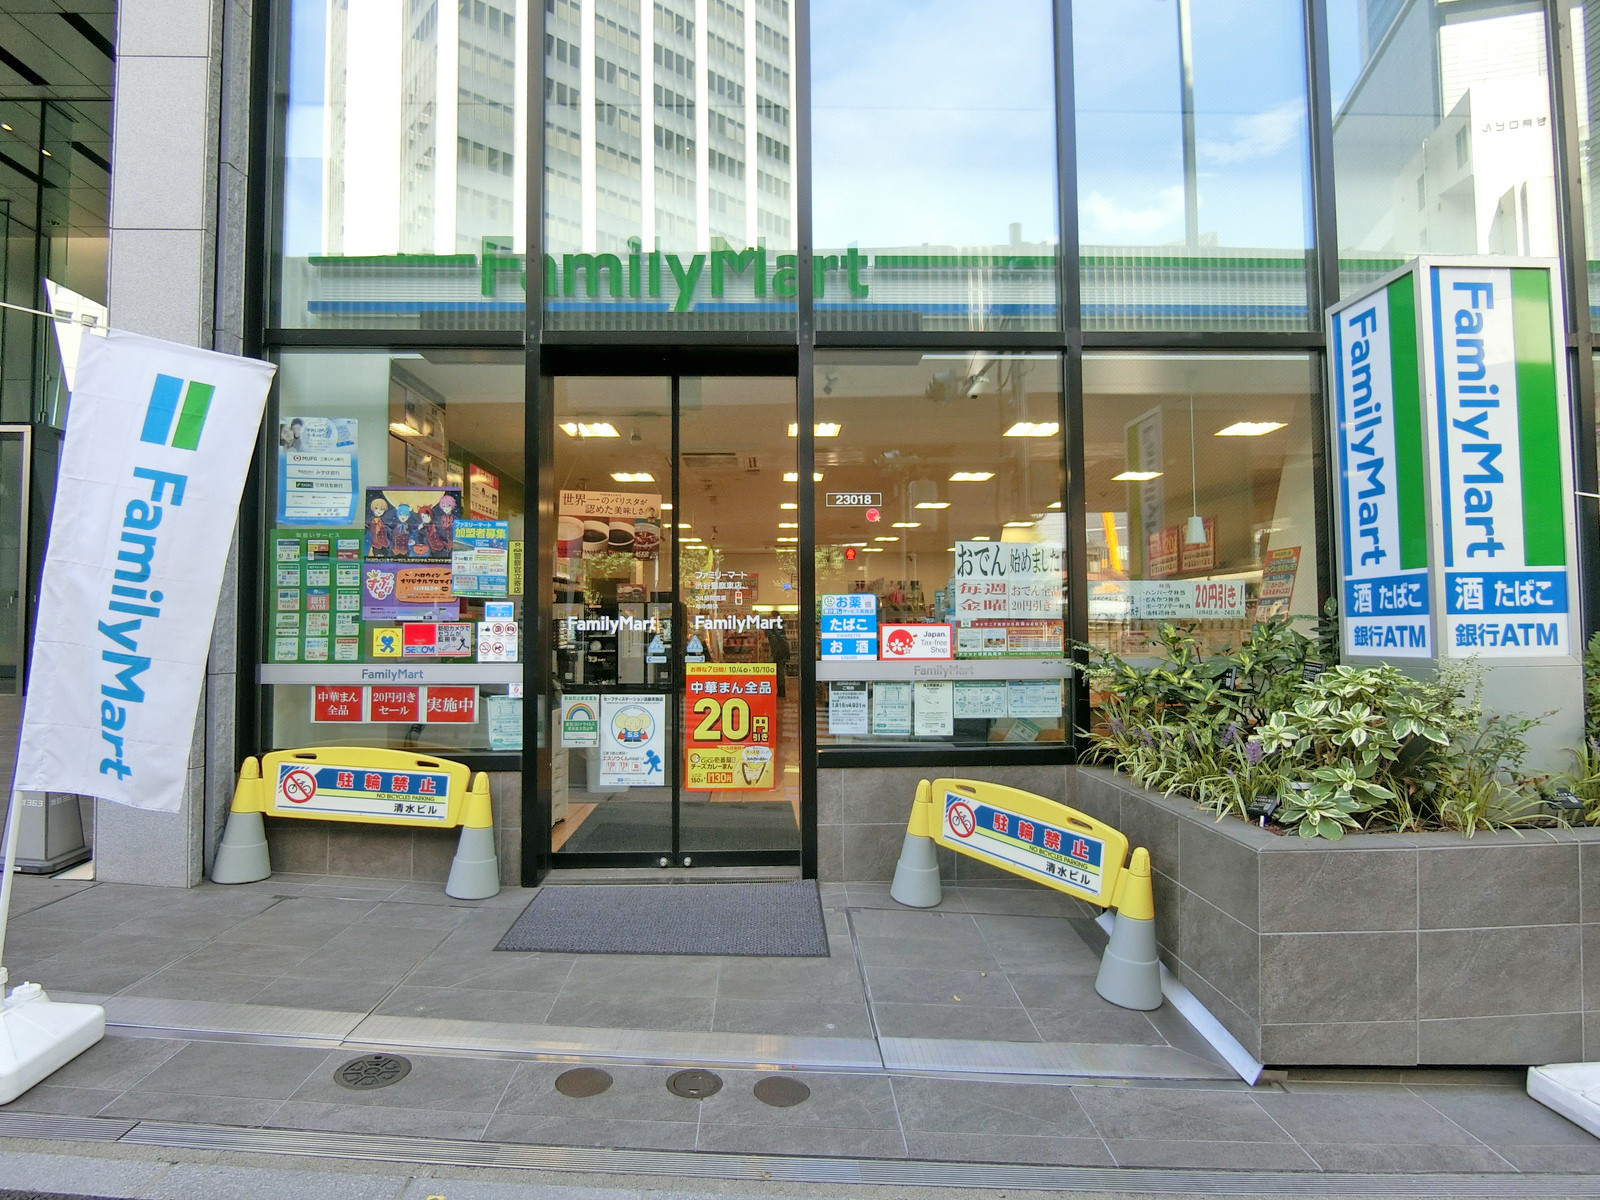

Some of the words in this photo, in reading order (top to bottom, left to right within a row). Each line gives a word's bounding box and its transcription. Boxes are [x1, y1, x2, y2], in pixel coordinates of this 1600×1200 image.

[1452, 281, 1506, 558] FamilyMart
[1348, 306, 1388, 566] FamilyMart
[562, 493, 648, 506] 世界一のバリスタが
[835, 494, 872, 505] 23018
[585, 504, 645, 516] 認めた美味しさ
[957, 544, 1008, 578] おでん
[1009, 547, 1060, 574] 始めました
[694, 571, 748, 580] ファミリーマート
[959, 582, 1008, 596] 毎週
[1455, 576, 1484, 611] 酒
[1494, 580, 1555, 607] たばこ
[836, 596, 862, 609] お薬
[1353, 583, 1373, 613] 酒
[1379, 582, 1423, 611] たばこ
[959, 598, 1008, 612] 金曜
[98, 466, 189, 783] FamilyMart
[567, 616, 657, 634] FamilyMart
[694, 615, 784, 634] FamilyMart
[829, 617, 869, 632] たばこ
[922, 630, 948, 639] Japan.
[1353, 624, 1427, 650] 銀行ATM
[1455, 622, 1560, 648] 銀行ATM
[405, 646, 435, 654] SECOM
[829, 640, 869, 654] お酒
[920, 639, 948, 647] Tax-free
[930, 646, 948, 655] Shop
[361, 668, 424, 682] FamilyMart
[913, 665, 975, 678] FamilyMart
[690, 680, 772, 695] 中華まん全品
[317, 691, 360, 703] 中華まん
[373, 692, 417, 703] 20円引き
[327, 704, 349, 716] 全品
[378, 705, 411, 716] セール
[426, 697, 474, 713] 実施中
[693, 697, 751, 742] 20
[336, 771, 437, 794] 駐輪禁止
[393, 802, 438, 815] 清水ビル
[992, 812, 1090, 861] 駐輪禁止
[1028, 844, 1037, 852] NO
[1037, 846, 1063, 864] BICYCLES
[1063, 856, 1089, 870] PARKING
[1045, 861, 1091, 886] 清水ビル
